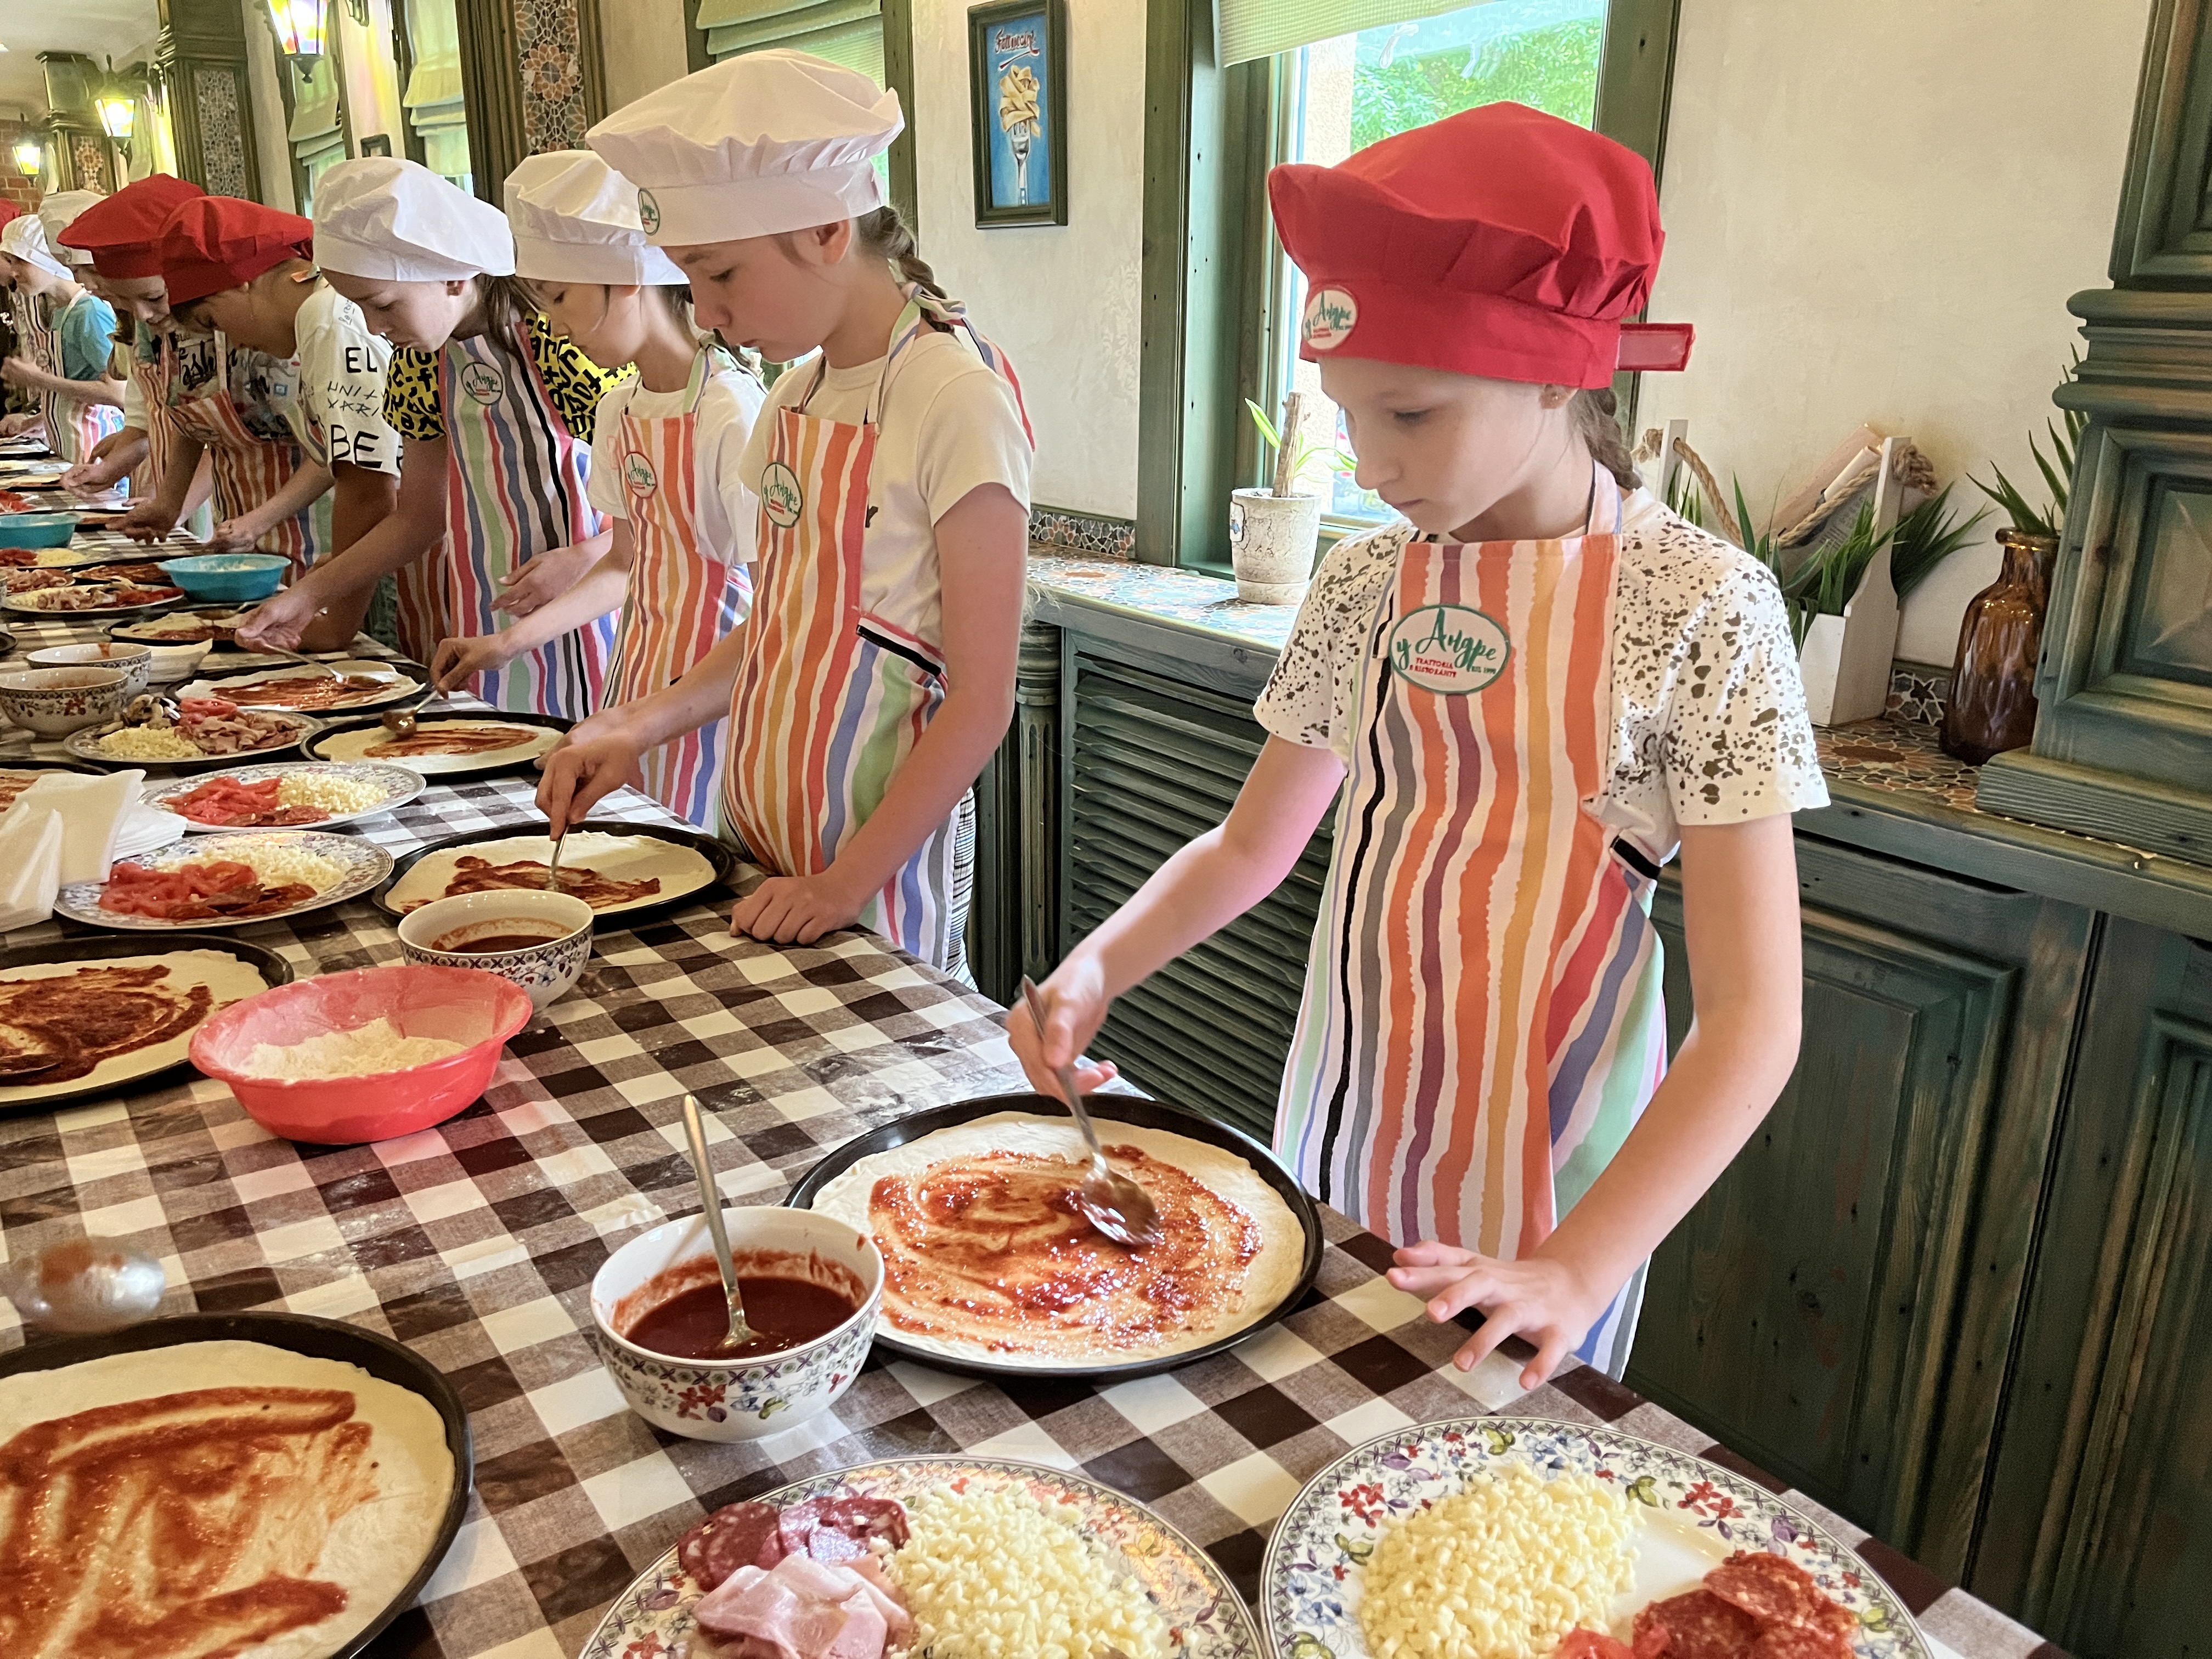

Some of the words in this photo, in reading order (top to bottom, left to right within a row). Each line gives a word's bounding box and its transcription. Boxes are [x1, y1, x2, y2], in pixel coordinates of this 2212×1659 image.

[345, 346, 377, 373] EL
[1415, 607, 1497, 672] Андре
[1414, 665, 1458, 678] RISTORANTE
[1415, 657, 1453, 669] TRATTORIA
